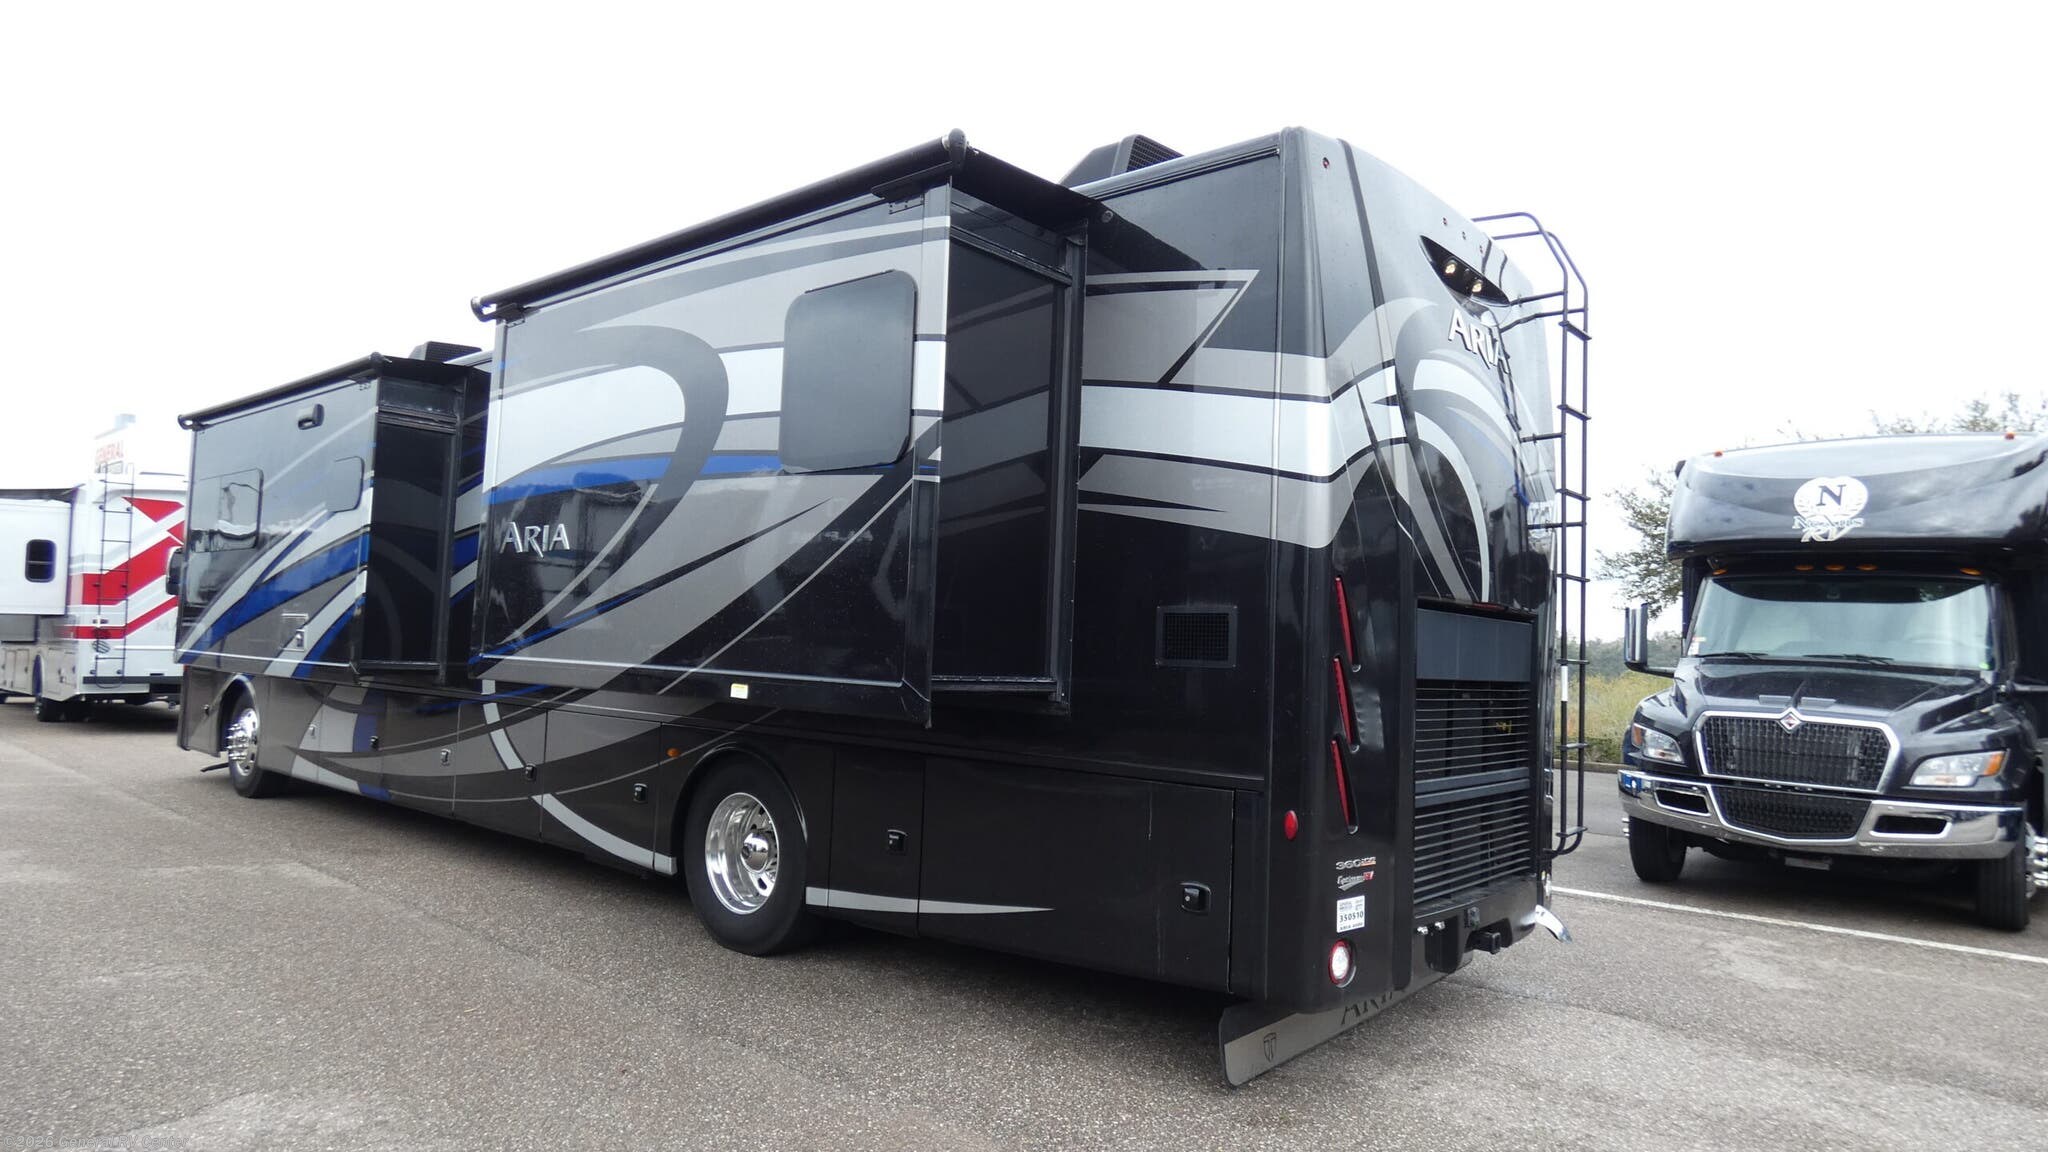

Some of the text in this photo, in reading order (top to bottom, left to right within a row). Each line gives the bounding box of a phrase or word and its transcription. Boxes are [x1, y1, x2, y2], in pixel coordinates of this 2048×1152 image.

[1447, 308, 1510, 375] ARIA
[1815, 483, 1847, 507] N
[499, 521, 571, 559] ARIA
[1339, 911, 1364, 923] 350510
